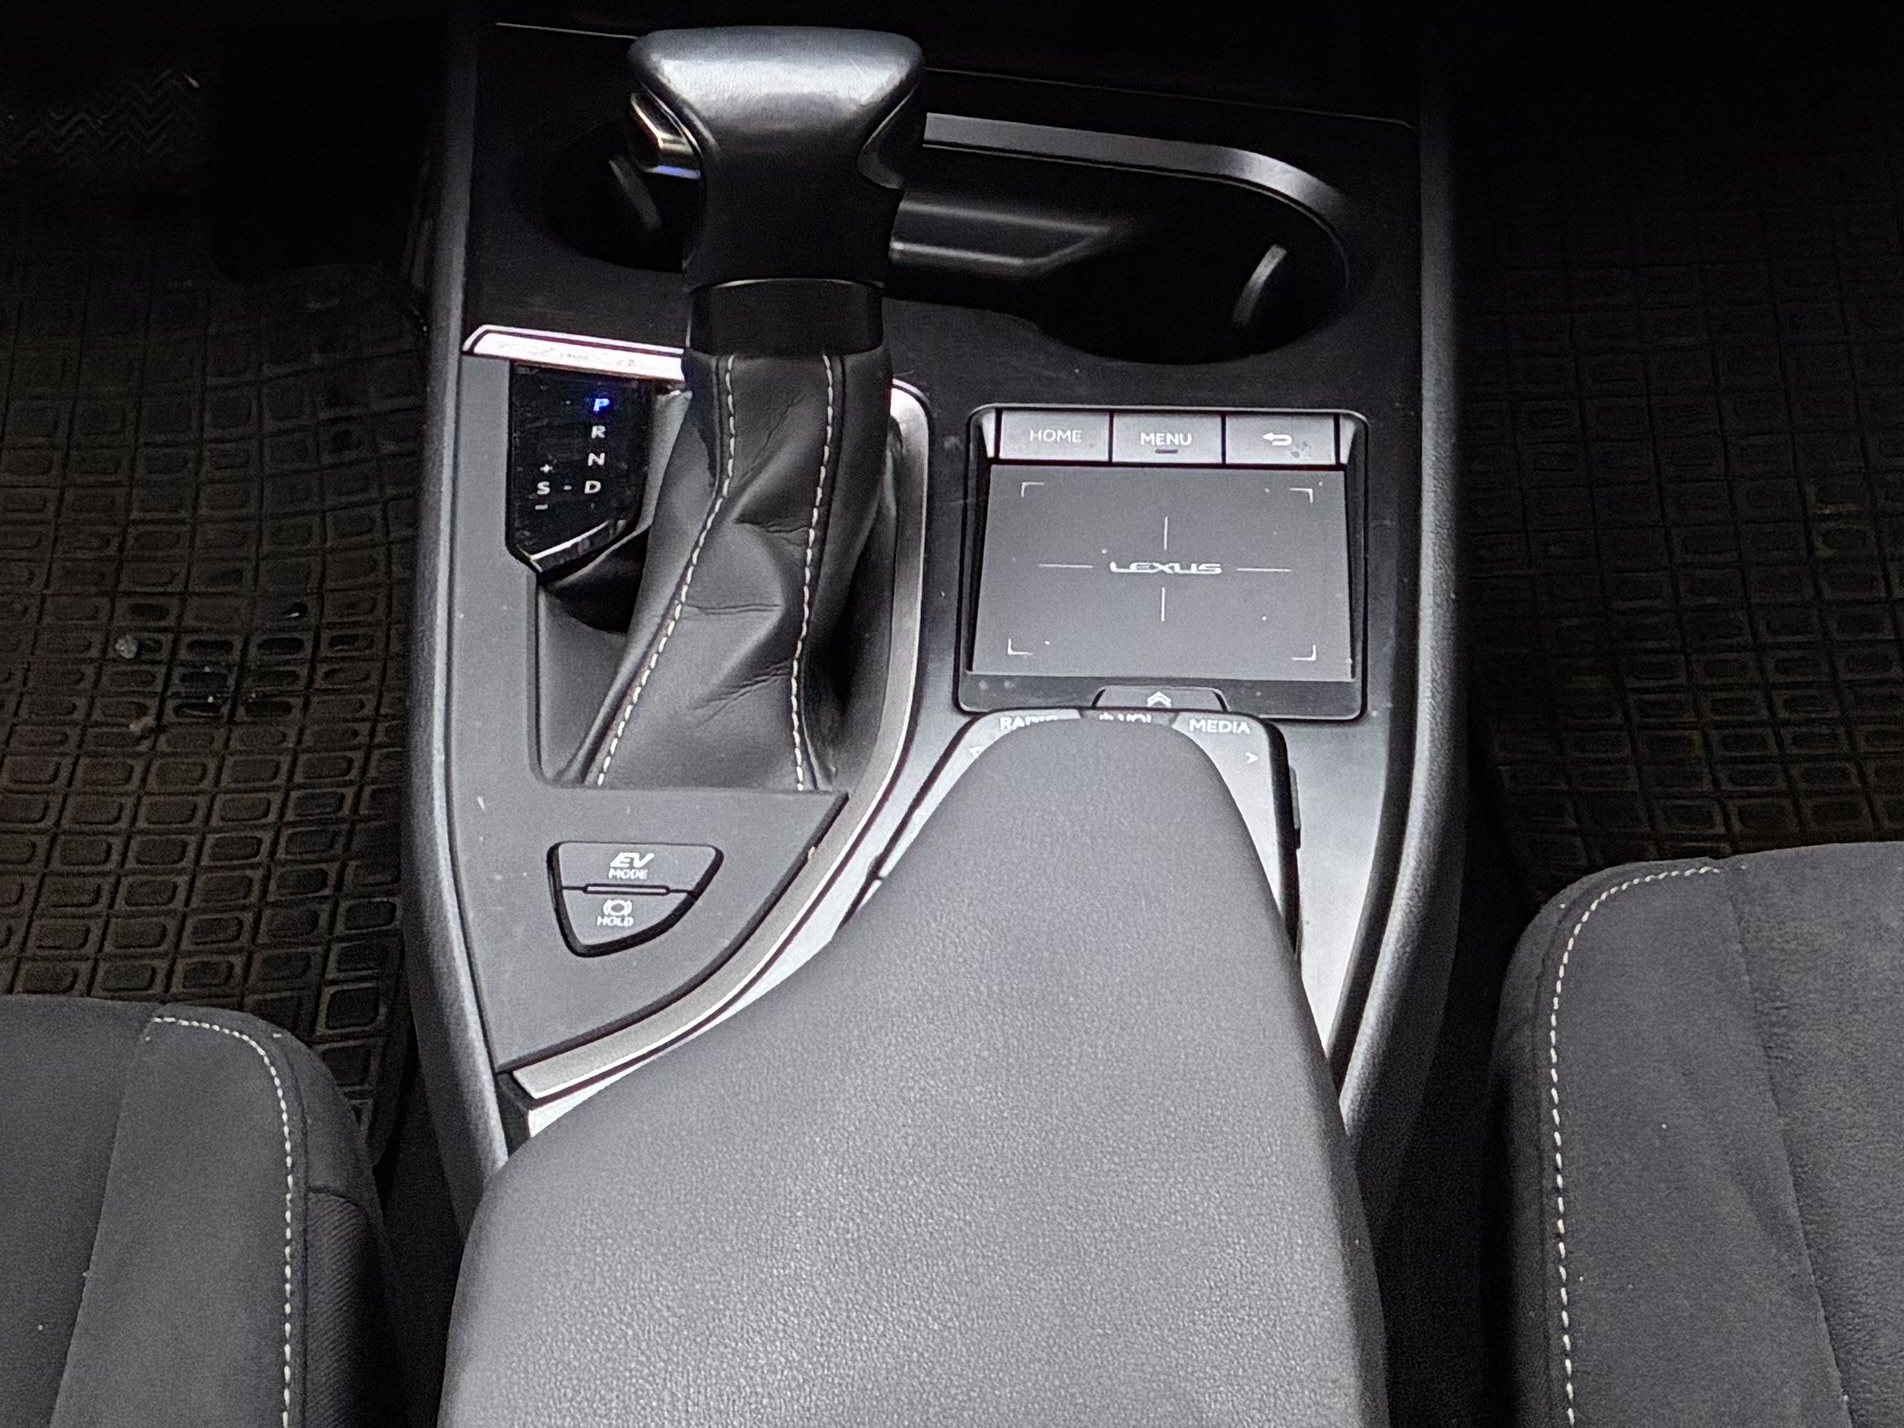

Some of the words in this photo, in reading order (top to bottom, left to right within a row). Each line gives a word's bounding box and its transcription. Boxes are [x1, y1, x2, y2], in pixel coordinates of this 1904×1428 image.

[592, 397, 610, 412] P
[591, 424, 606, 439] R
[1029, 429, 1083, 443] HOME
[1140, 432, 1193, 446] MENU
[587, 451, 606, 467] N
[536, 481, 551, 495] S
[584, 480, 602, 494] D
[1109, 561, 1223, 575] LEXUS
[1189, 718, 1251, 734] MEDIA
[609, 851, 655, 868] EV
[608, 869, 649, 880] MODE
[596, 916, 635, 927] HOLD
